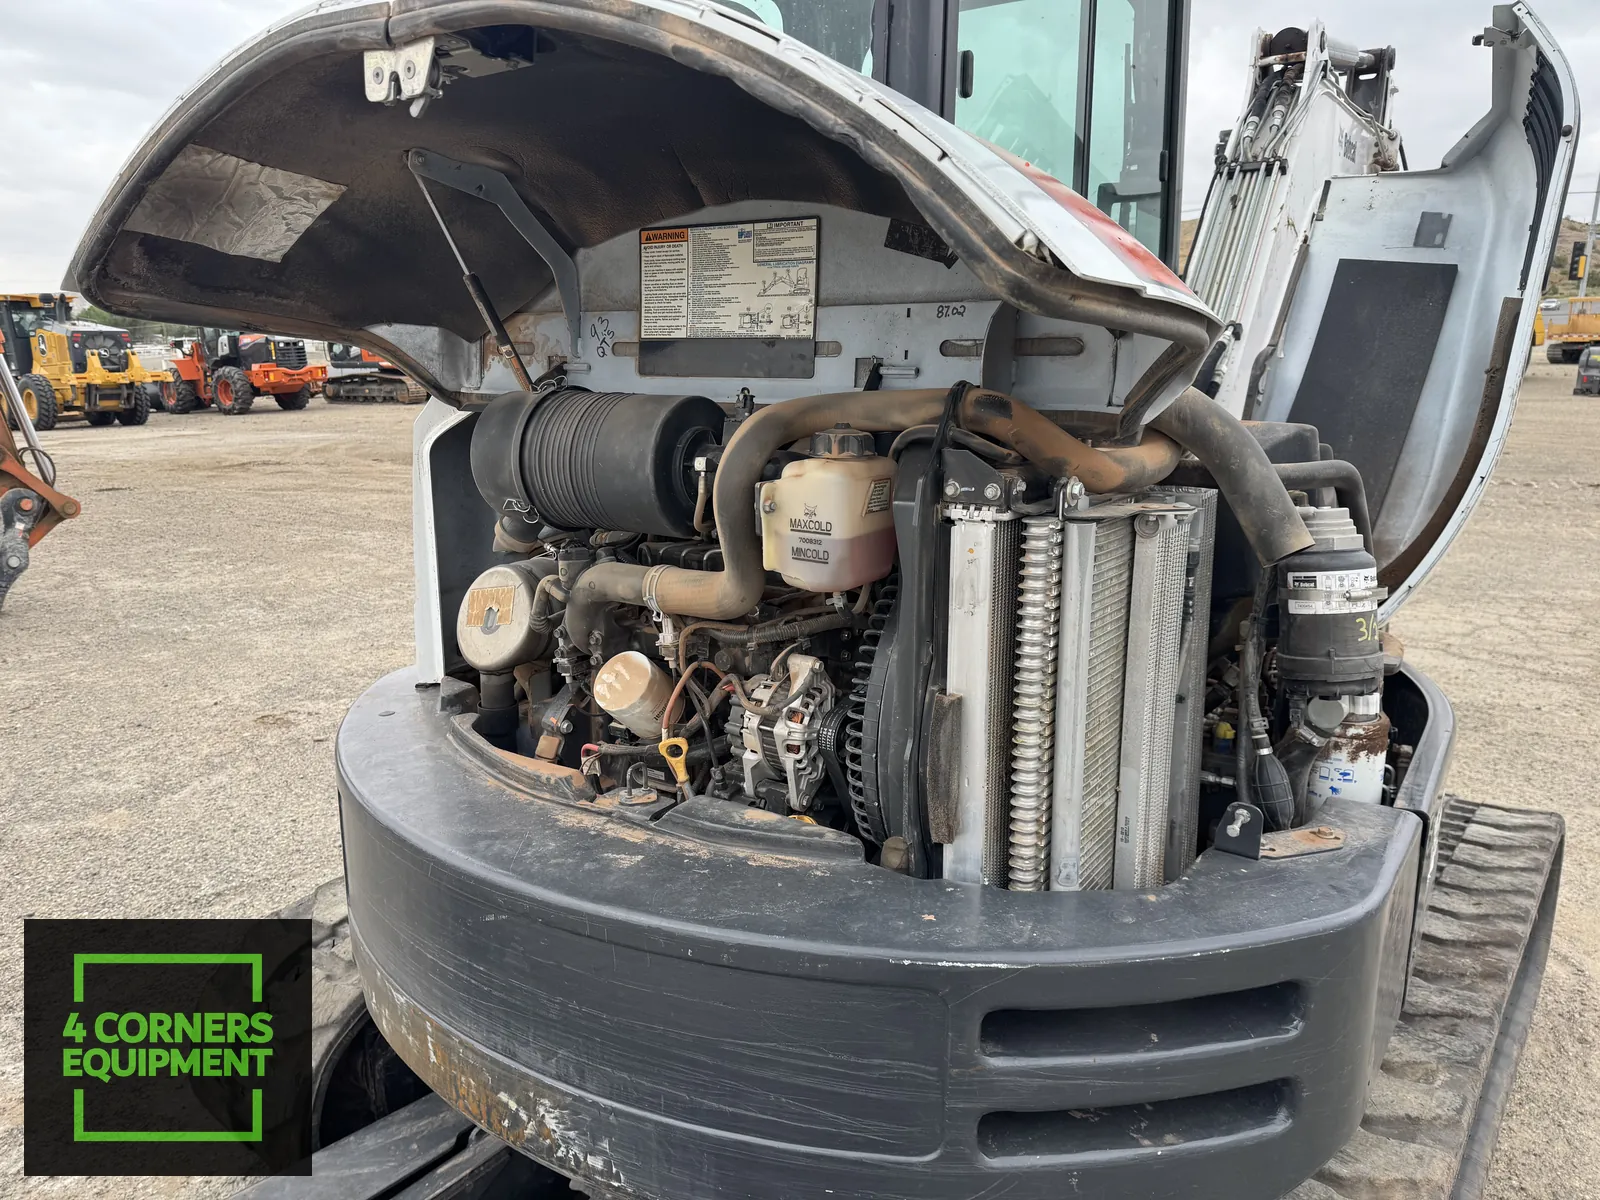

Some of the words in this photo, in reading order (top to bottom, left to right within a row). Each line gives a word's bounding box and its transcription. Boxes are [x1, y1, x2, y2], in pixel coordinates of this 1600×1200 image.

[651, 231, 685, 241] WARNING
[789, 518, 832, 532] MAXCOLD
[791, 546, 830, 561] MINCOLD
